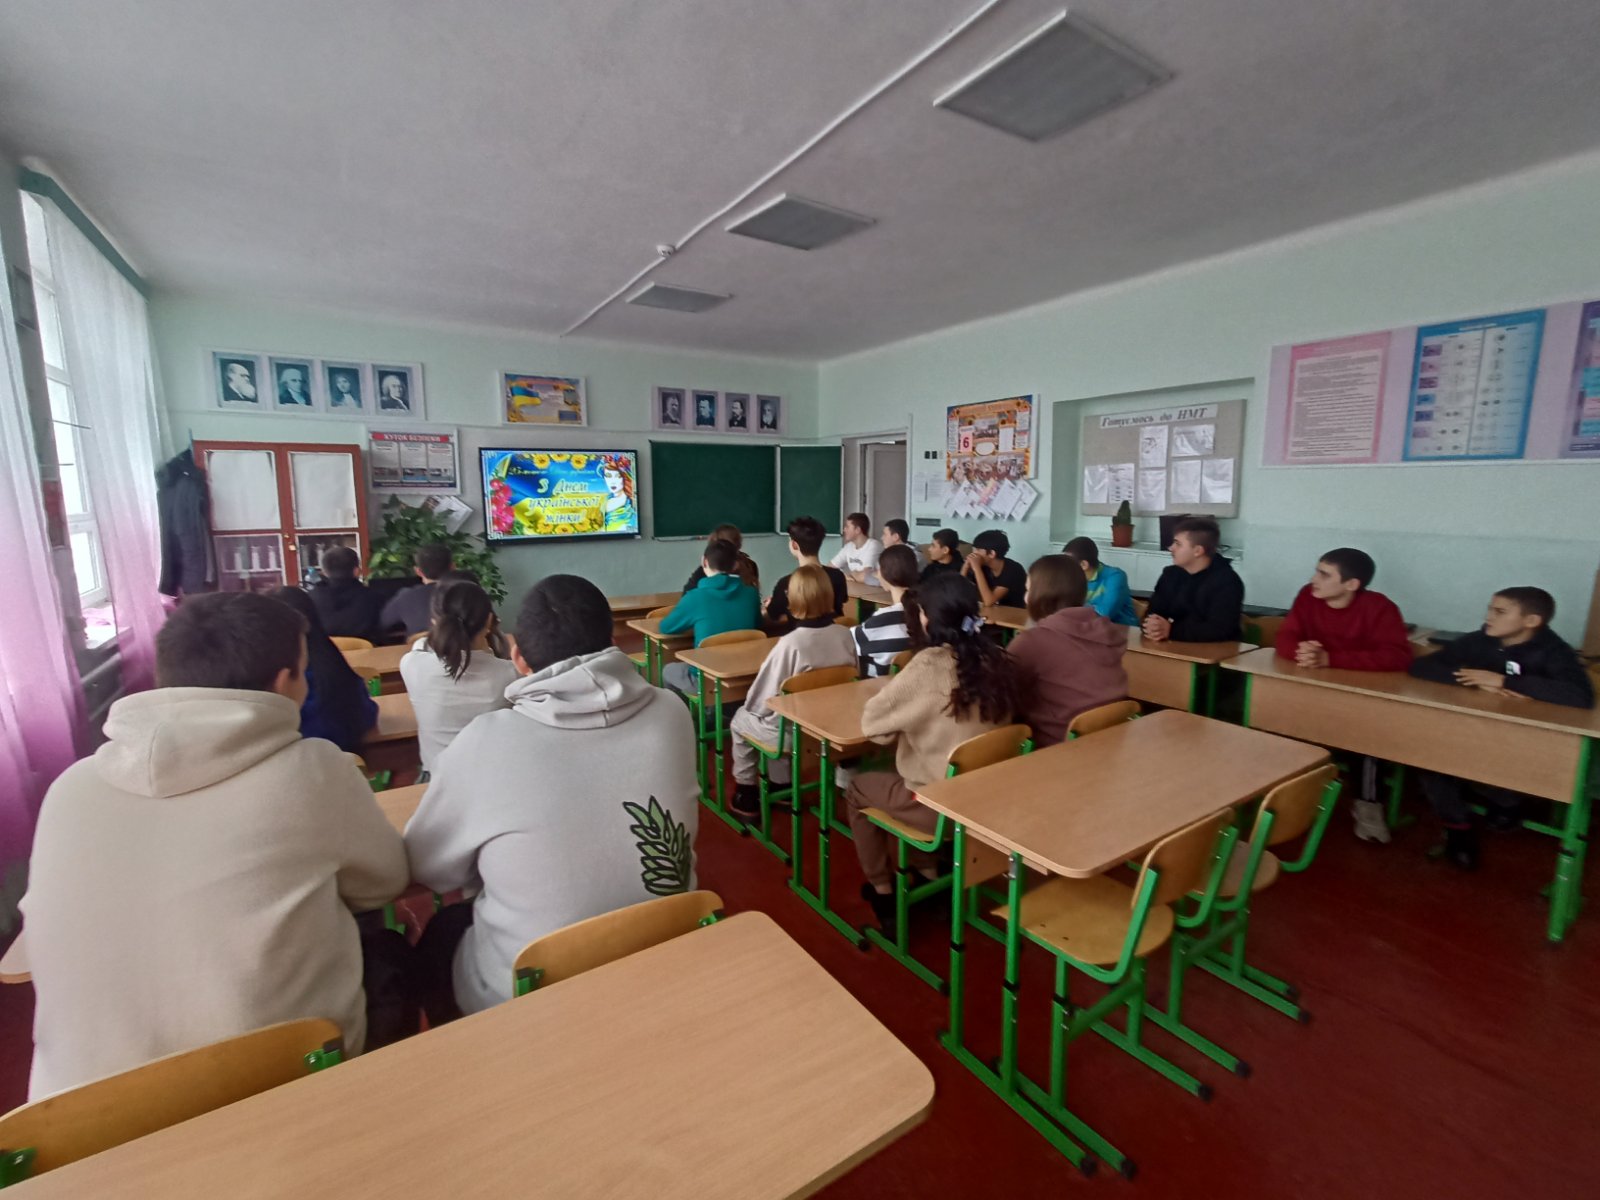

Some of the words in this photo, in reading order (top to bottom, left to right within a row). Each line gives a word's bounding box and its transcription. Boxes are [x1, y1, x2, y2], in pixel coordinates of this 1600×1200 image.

[1177, 407, 1208, 420] НМТ
[963, 437, 970, 448] 6
[525, 495, 600, 516] української
